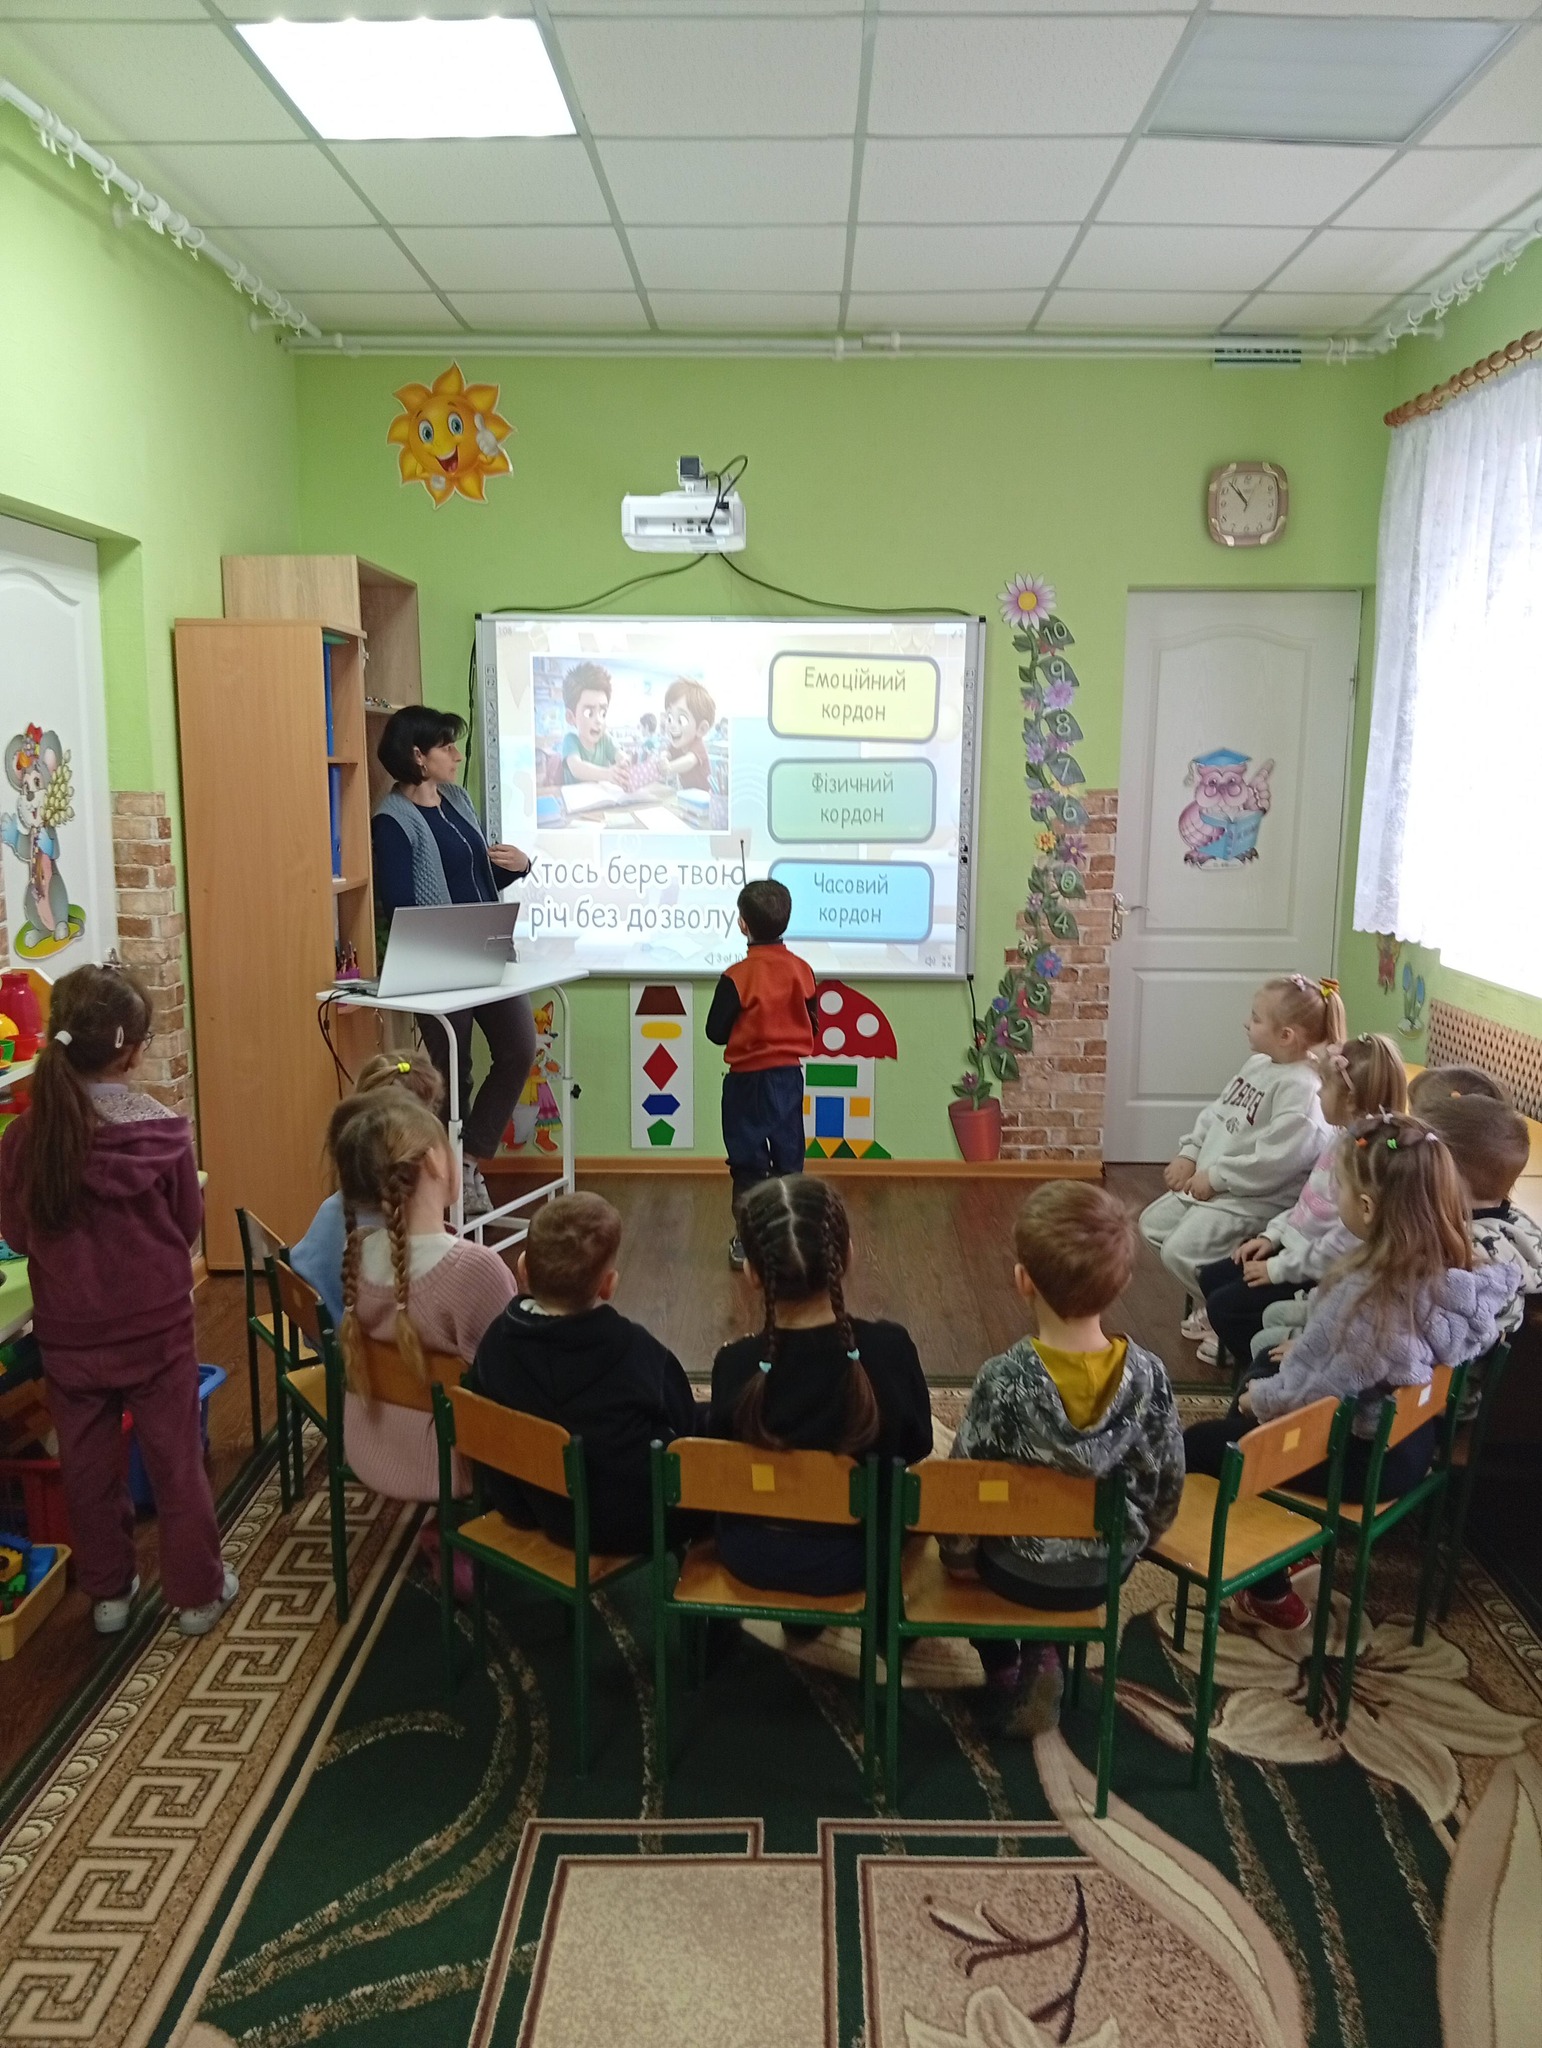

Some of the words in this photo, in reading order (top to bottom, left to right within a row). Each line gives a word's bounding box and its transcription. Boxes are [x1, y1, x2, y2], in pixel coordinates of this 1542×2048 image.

[1043, 621, 1068, 646] 10
[804, 666, 906, 692] Емоційний
[1050, 660, 1065, 684] 9
[821, 703, 886, 726] кордон
[1056, 713, 1072, 736] 8
[1057, 757, 1071, 782] 7
[811, 771, 894, 794] Фізичний
[820, 807, 884, 829] кордон
[1063, 798, 1078, 821] 6
[522, 855, 599, 885] Хтось
[607, 855, 669, 894] бере
[677, 863, 745, 886] твою
[813, 872, 889, 895] Часовий
[531, 900, 568, 938] річ
[576, 899, 619, 929] без
[627, 907, 736, 939] дозволу
[819, 907, 881, 928] кордон
[1053, 910, 1069, 935] 4
[1029, 983, 1048, 1006] 3
[1009, 1019, 1029, 1043] 2
[999, 1052, 1008, 1075] 1
